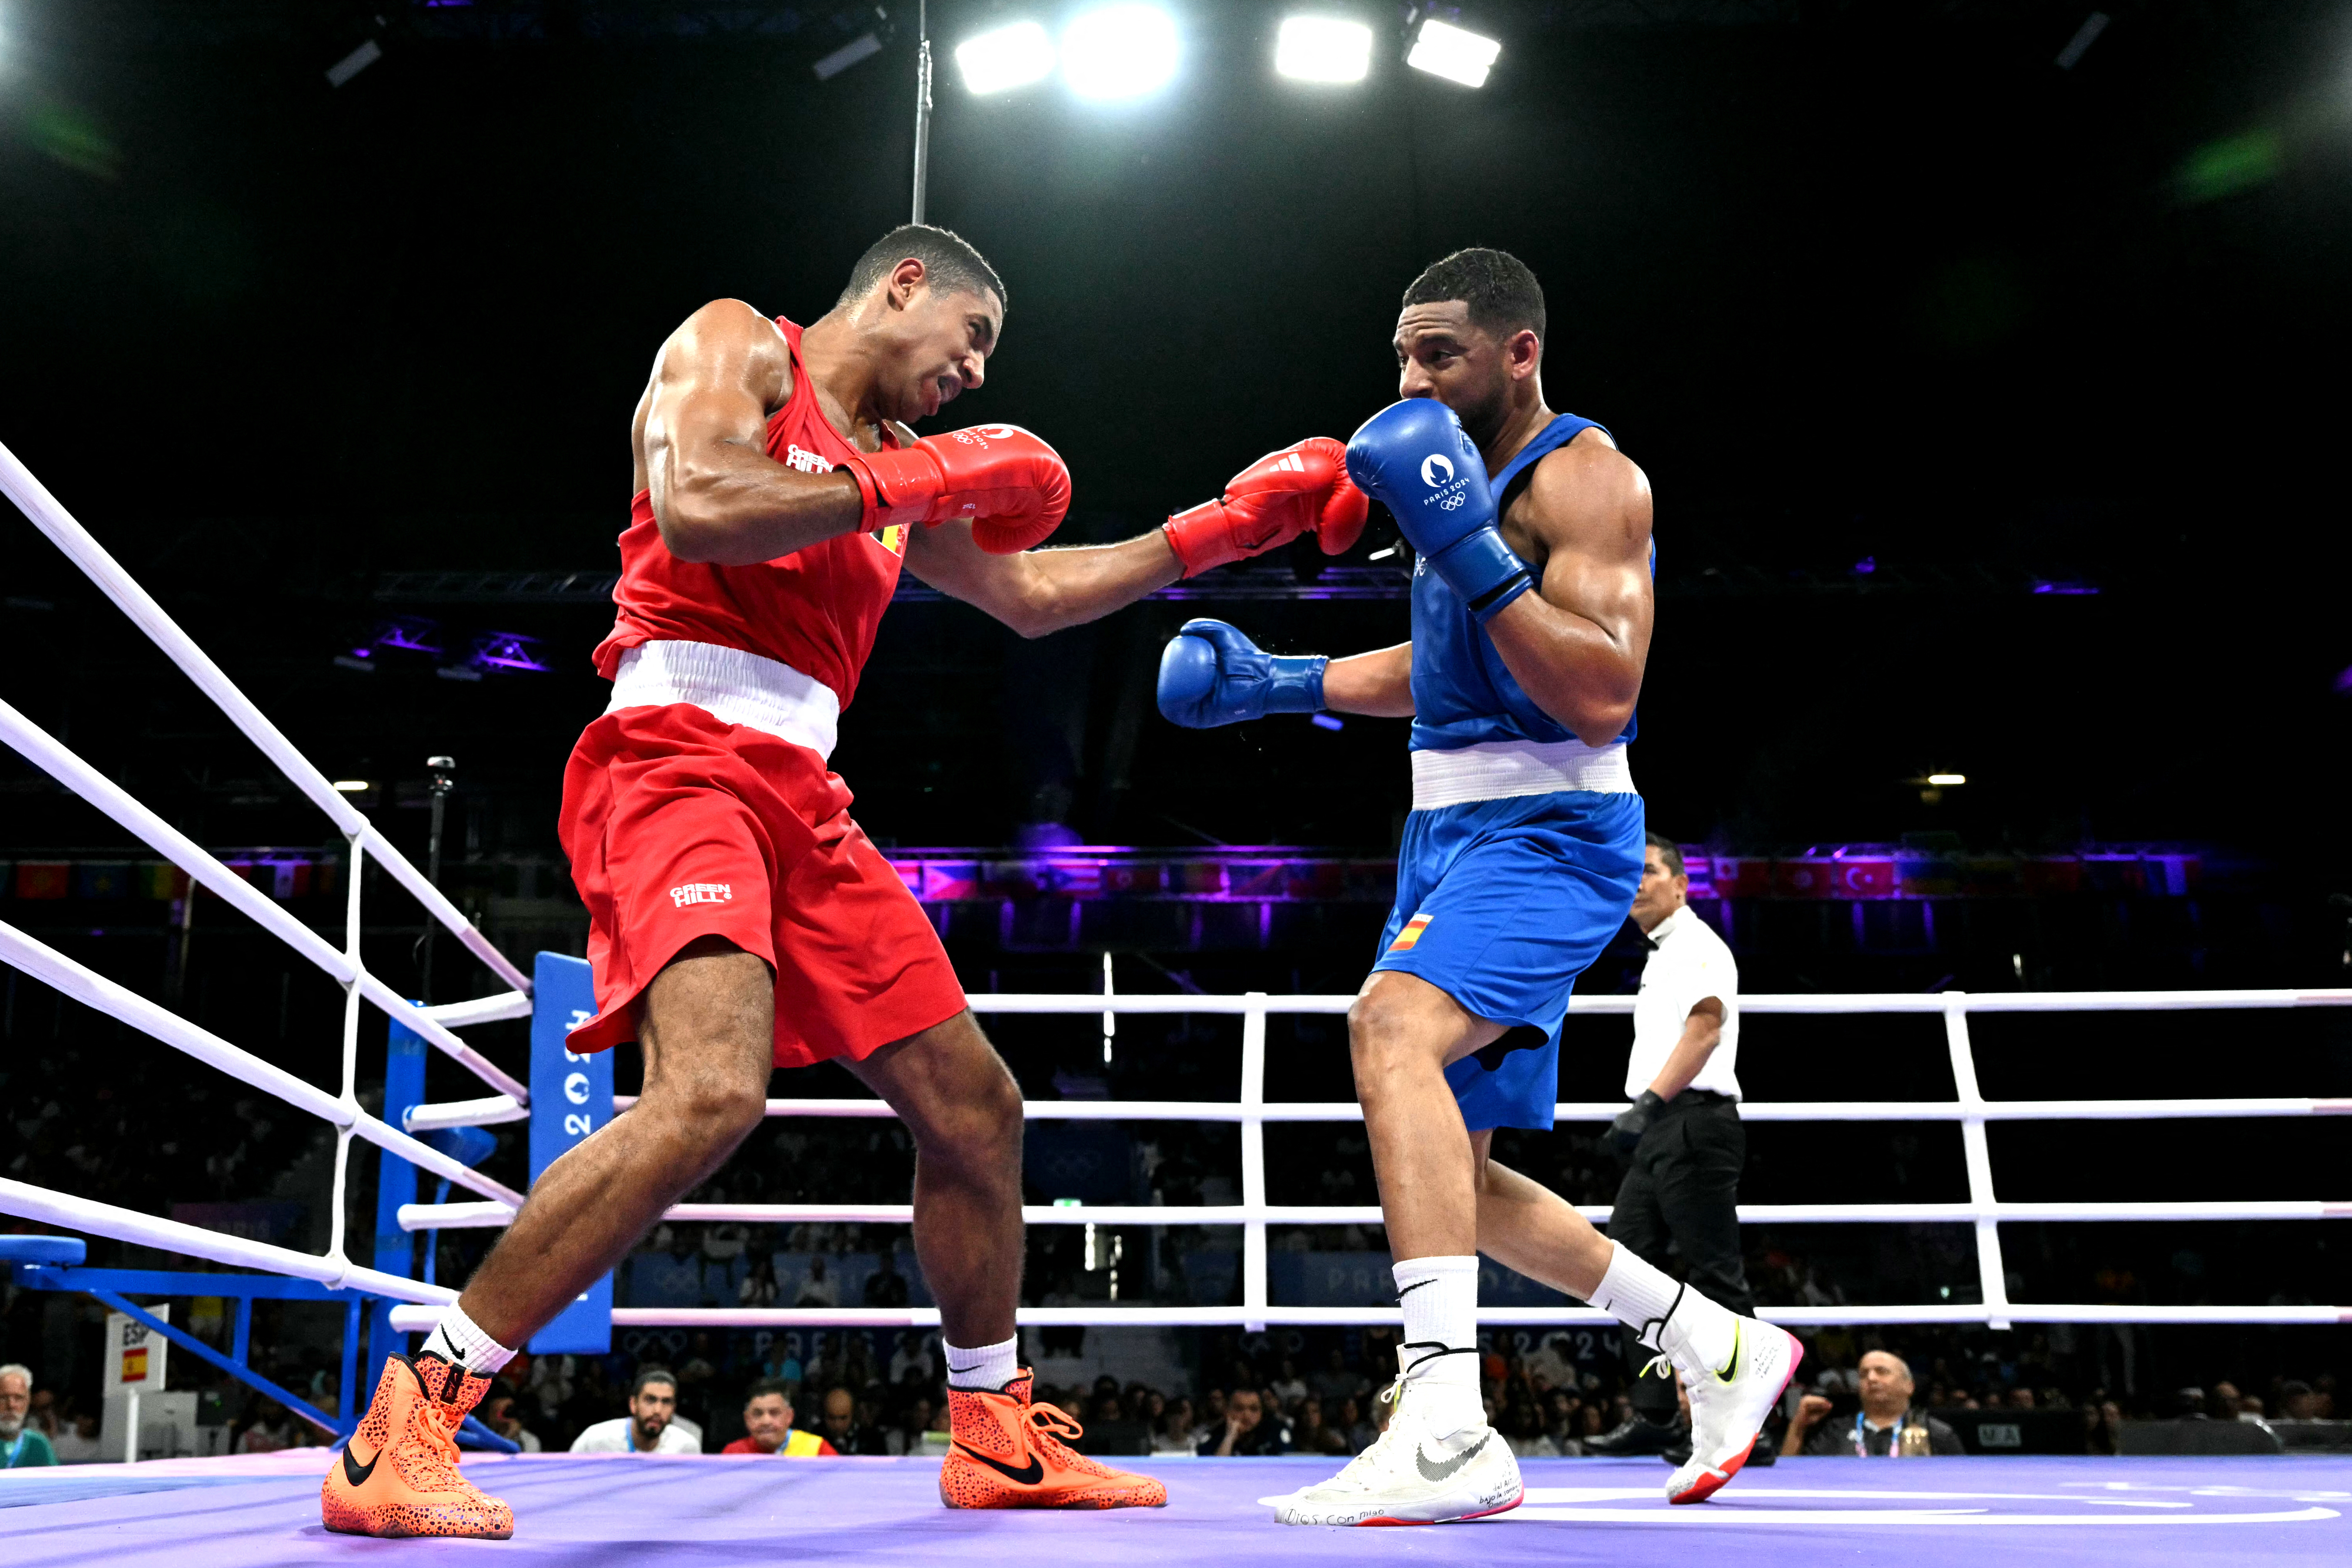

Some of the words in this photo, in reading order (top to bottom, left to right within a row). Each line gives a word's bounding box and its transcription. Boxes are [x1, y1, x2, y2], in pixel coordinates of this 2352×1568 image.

[1424, 489, 1448, 506] PARIS
[1450, 477, 1469, 492] 2024
[670, 883, 731, 897] GREEN
[674, 891, 724, 908] HILL
